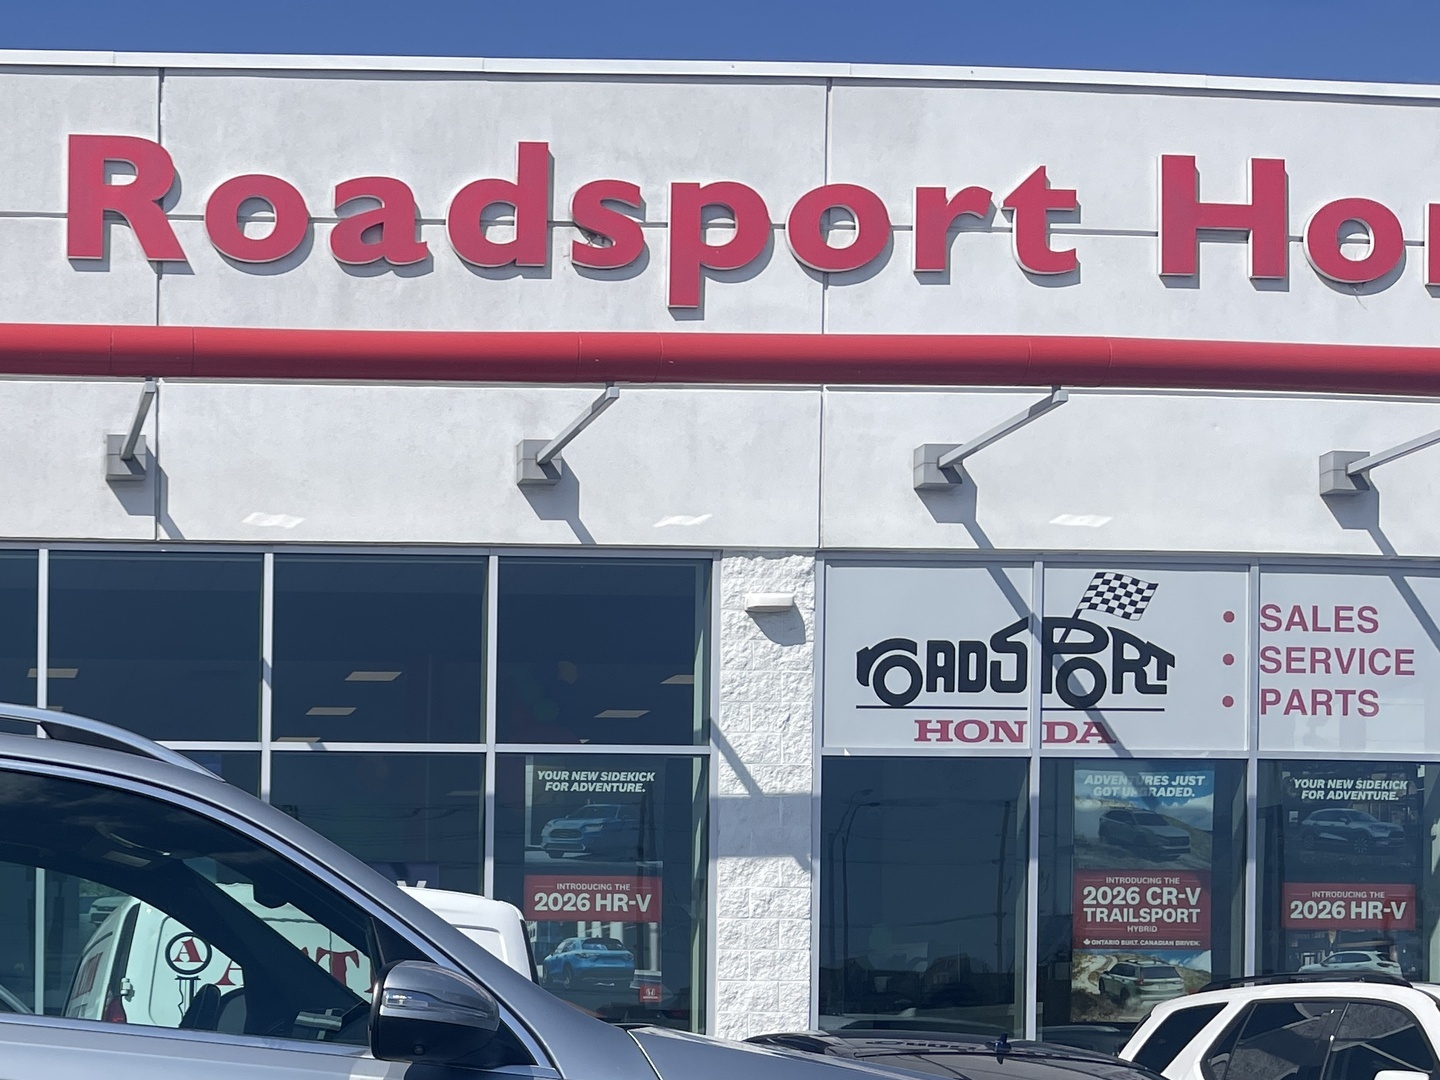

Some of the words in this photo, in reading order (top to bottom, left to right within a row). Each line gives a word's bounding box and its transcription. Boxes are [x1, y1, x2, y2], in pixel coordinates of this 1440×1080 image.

[67, 134, 1077, 308] Roadsport
[1260, 603, 1378, 633] SALES
[1260, 646, 1415, 676] SERVICE
[1260, 689, 1379, 717] PARTS
[914, 719, 1117, 744] HONDA
[537, 770, 569, 781] YOUR
[571, 771, 599, 781] NEW
[600, 771, 655, 782] SIDEKICK
[1171, 775, 1206, 786] JUST
[544, 782, 569, 792] FOR
[570, 782, 646, 792] ADVENTURE.
[1093, 786, 1119, 797] GOT
[1294, 779, 1325, 789] YOUR
[1327, 779, 1354, 789] NEW
[1355, 780, 1408, 790] SIDEKICK
[1301, 790, 1325, 799] FOR
[1326, 790, 1399, 800] ADVENTURE.
[1105, 876, 1162, 884] INTRODUCING
[534, 892, 591, 911] 2026
[595, 893, 652, 912] HR-V
[1083, 886, 1140, 905] 2026
[1146, 887, 1201, 906] CR-V
[1083, 907, 1200, 923] TRAILSPORT
[1290, 900, 1346, 919] 2026
[1350, 901, 1407, 919] HR-V
[1127, 925, 1158, 933] HYBRID
[1140, 939, 1174, 947] CANADIAN
